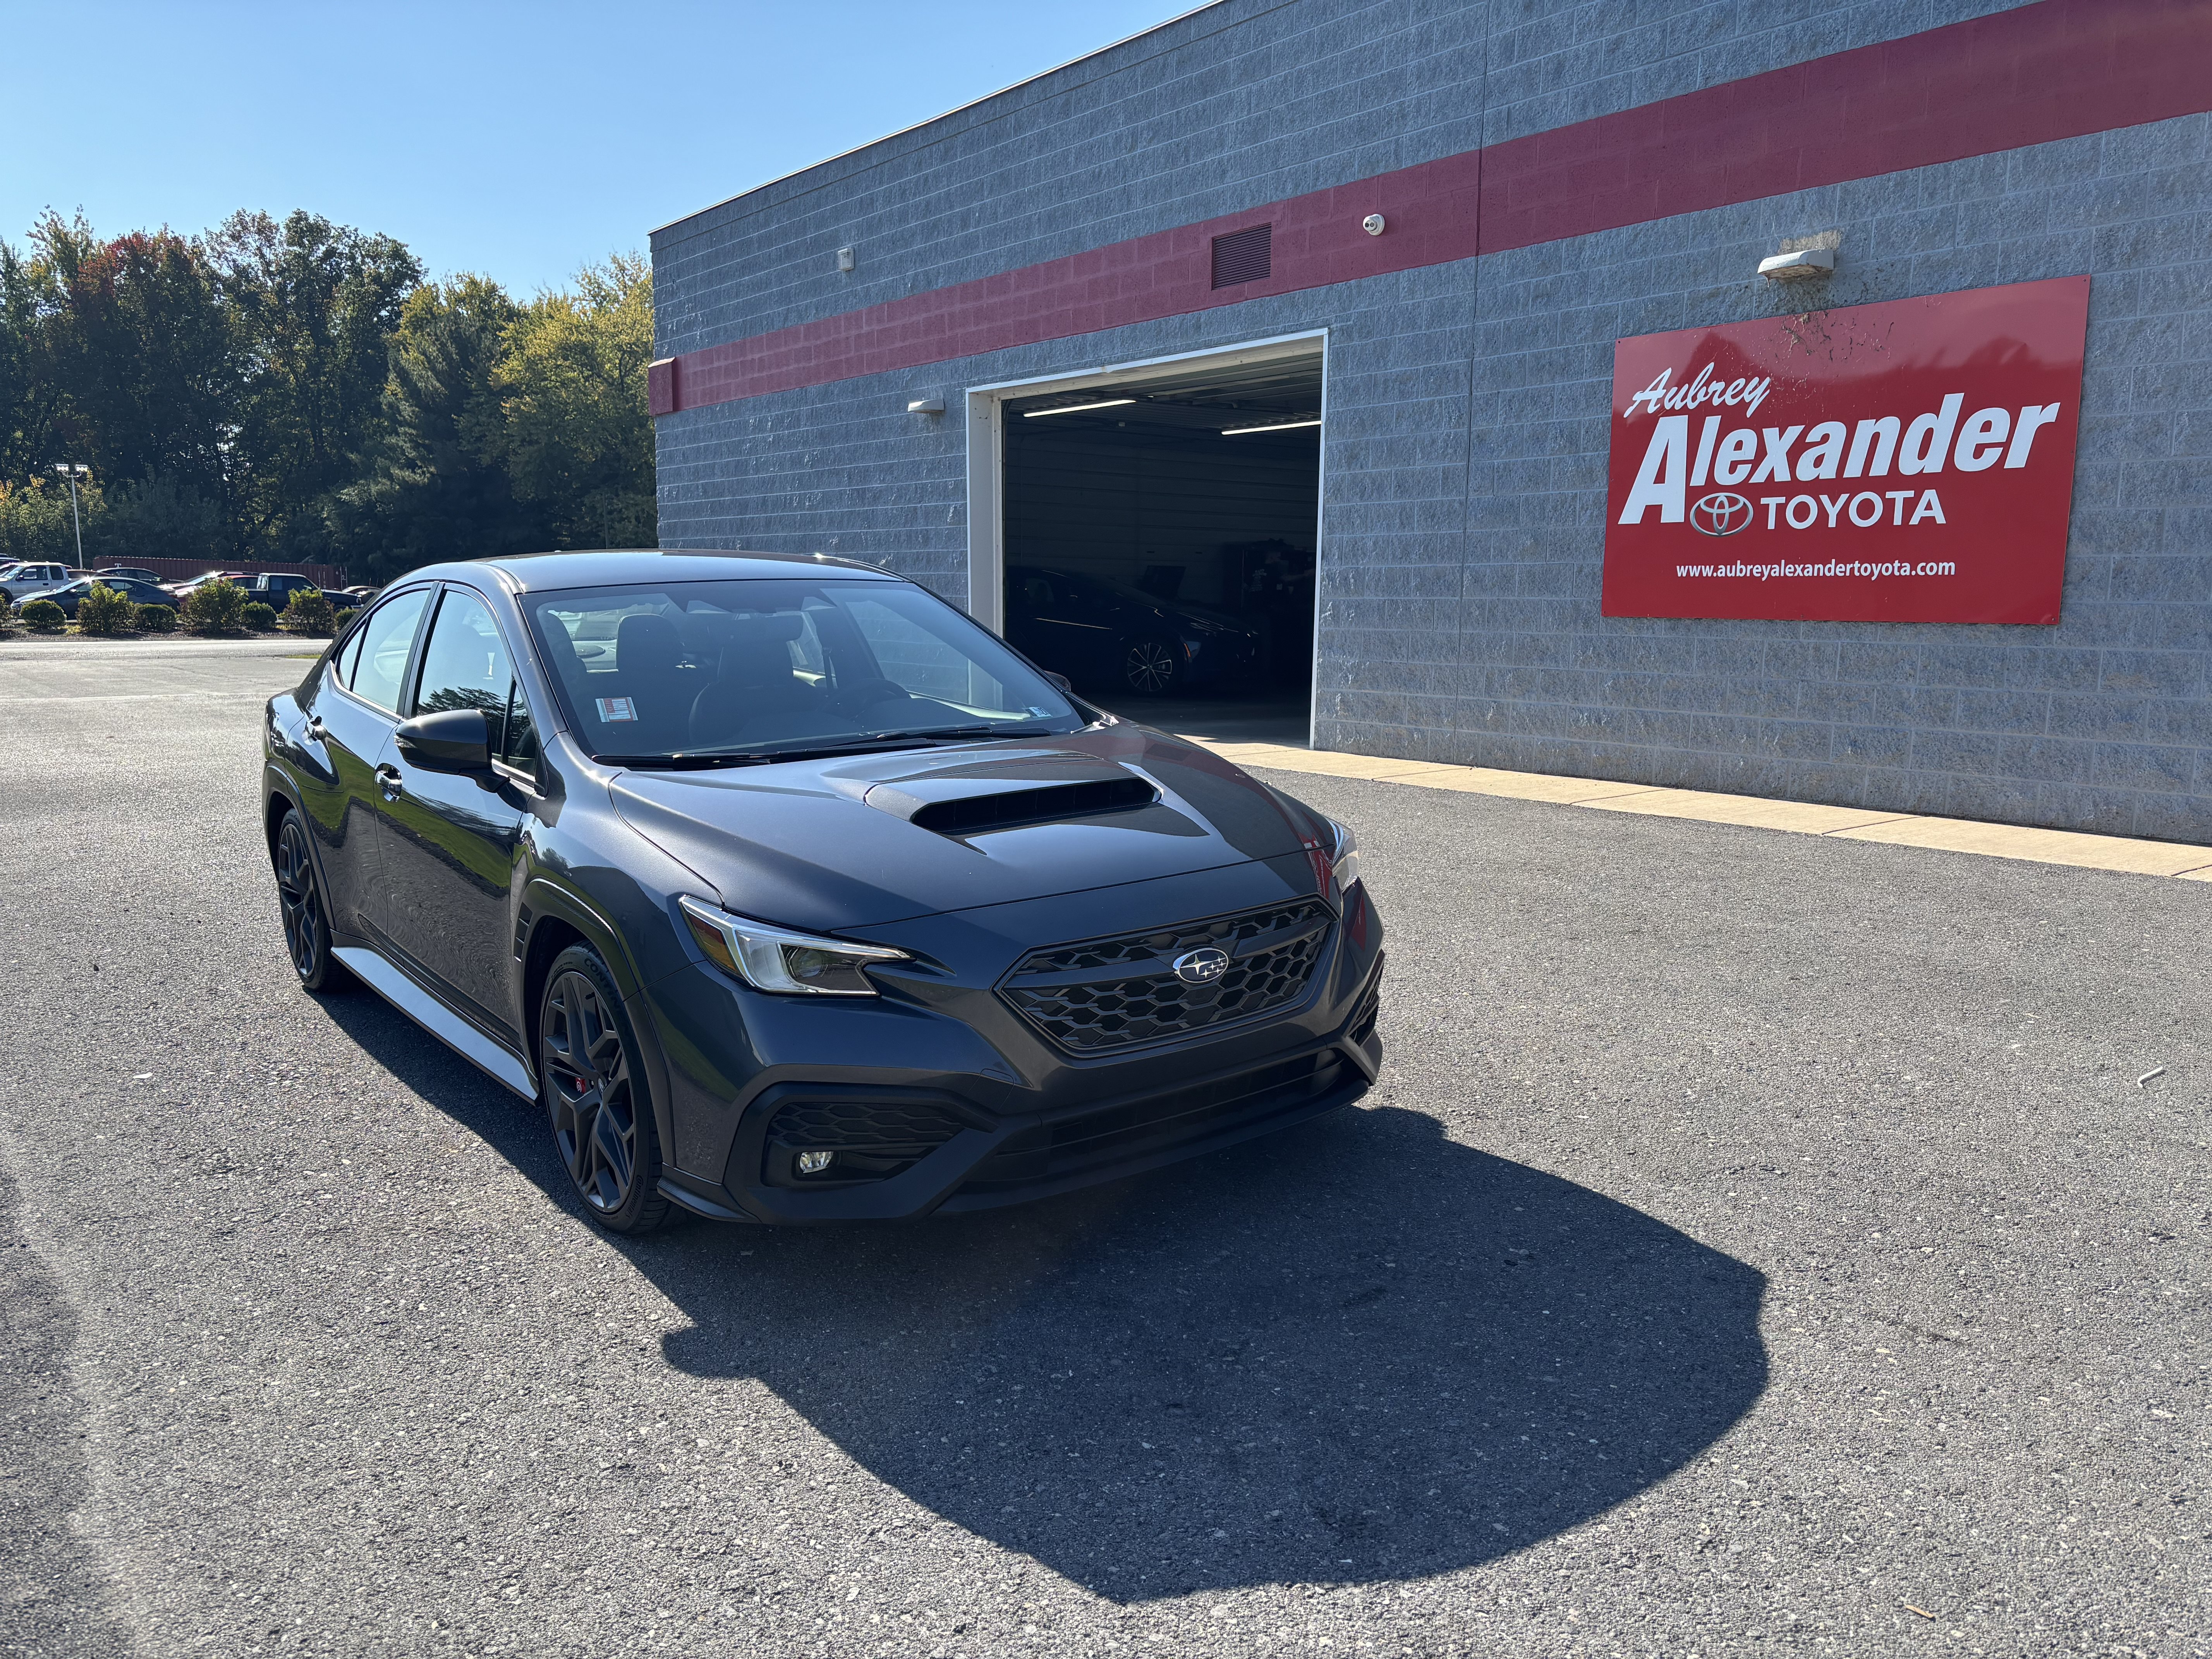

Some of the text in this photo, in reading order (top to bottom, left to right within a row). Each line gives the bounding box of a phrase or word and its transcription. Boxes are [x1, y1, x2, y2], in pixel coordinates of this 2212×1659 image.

[1623, 362, 1770, 418] Aubrey
[1618, 392, 2061, 524] Alexander
[1760, 489, 1946, 529] TOYOTA
[1676, 559, 1956, 581] www.aubreyalexandertoyota.com
